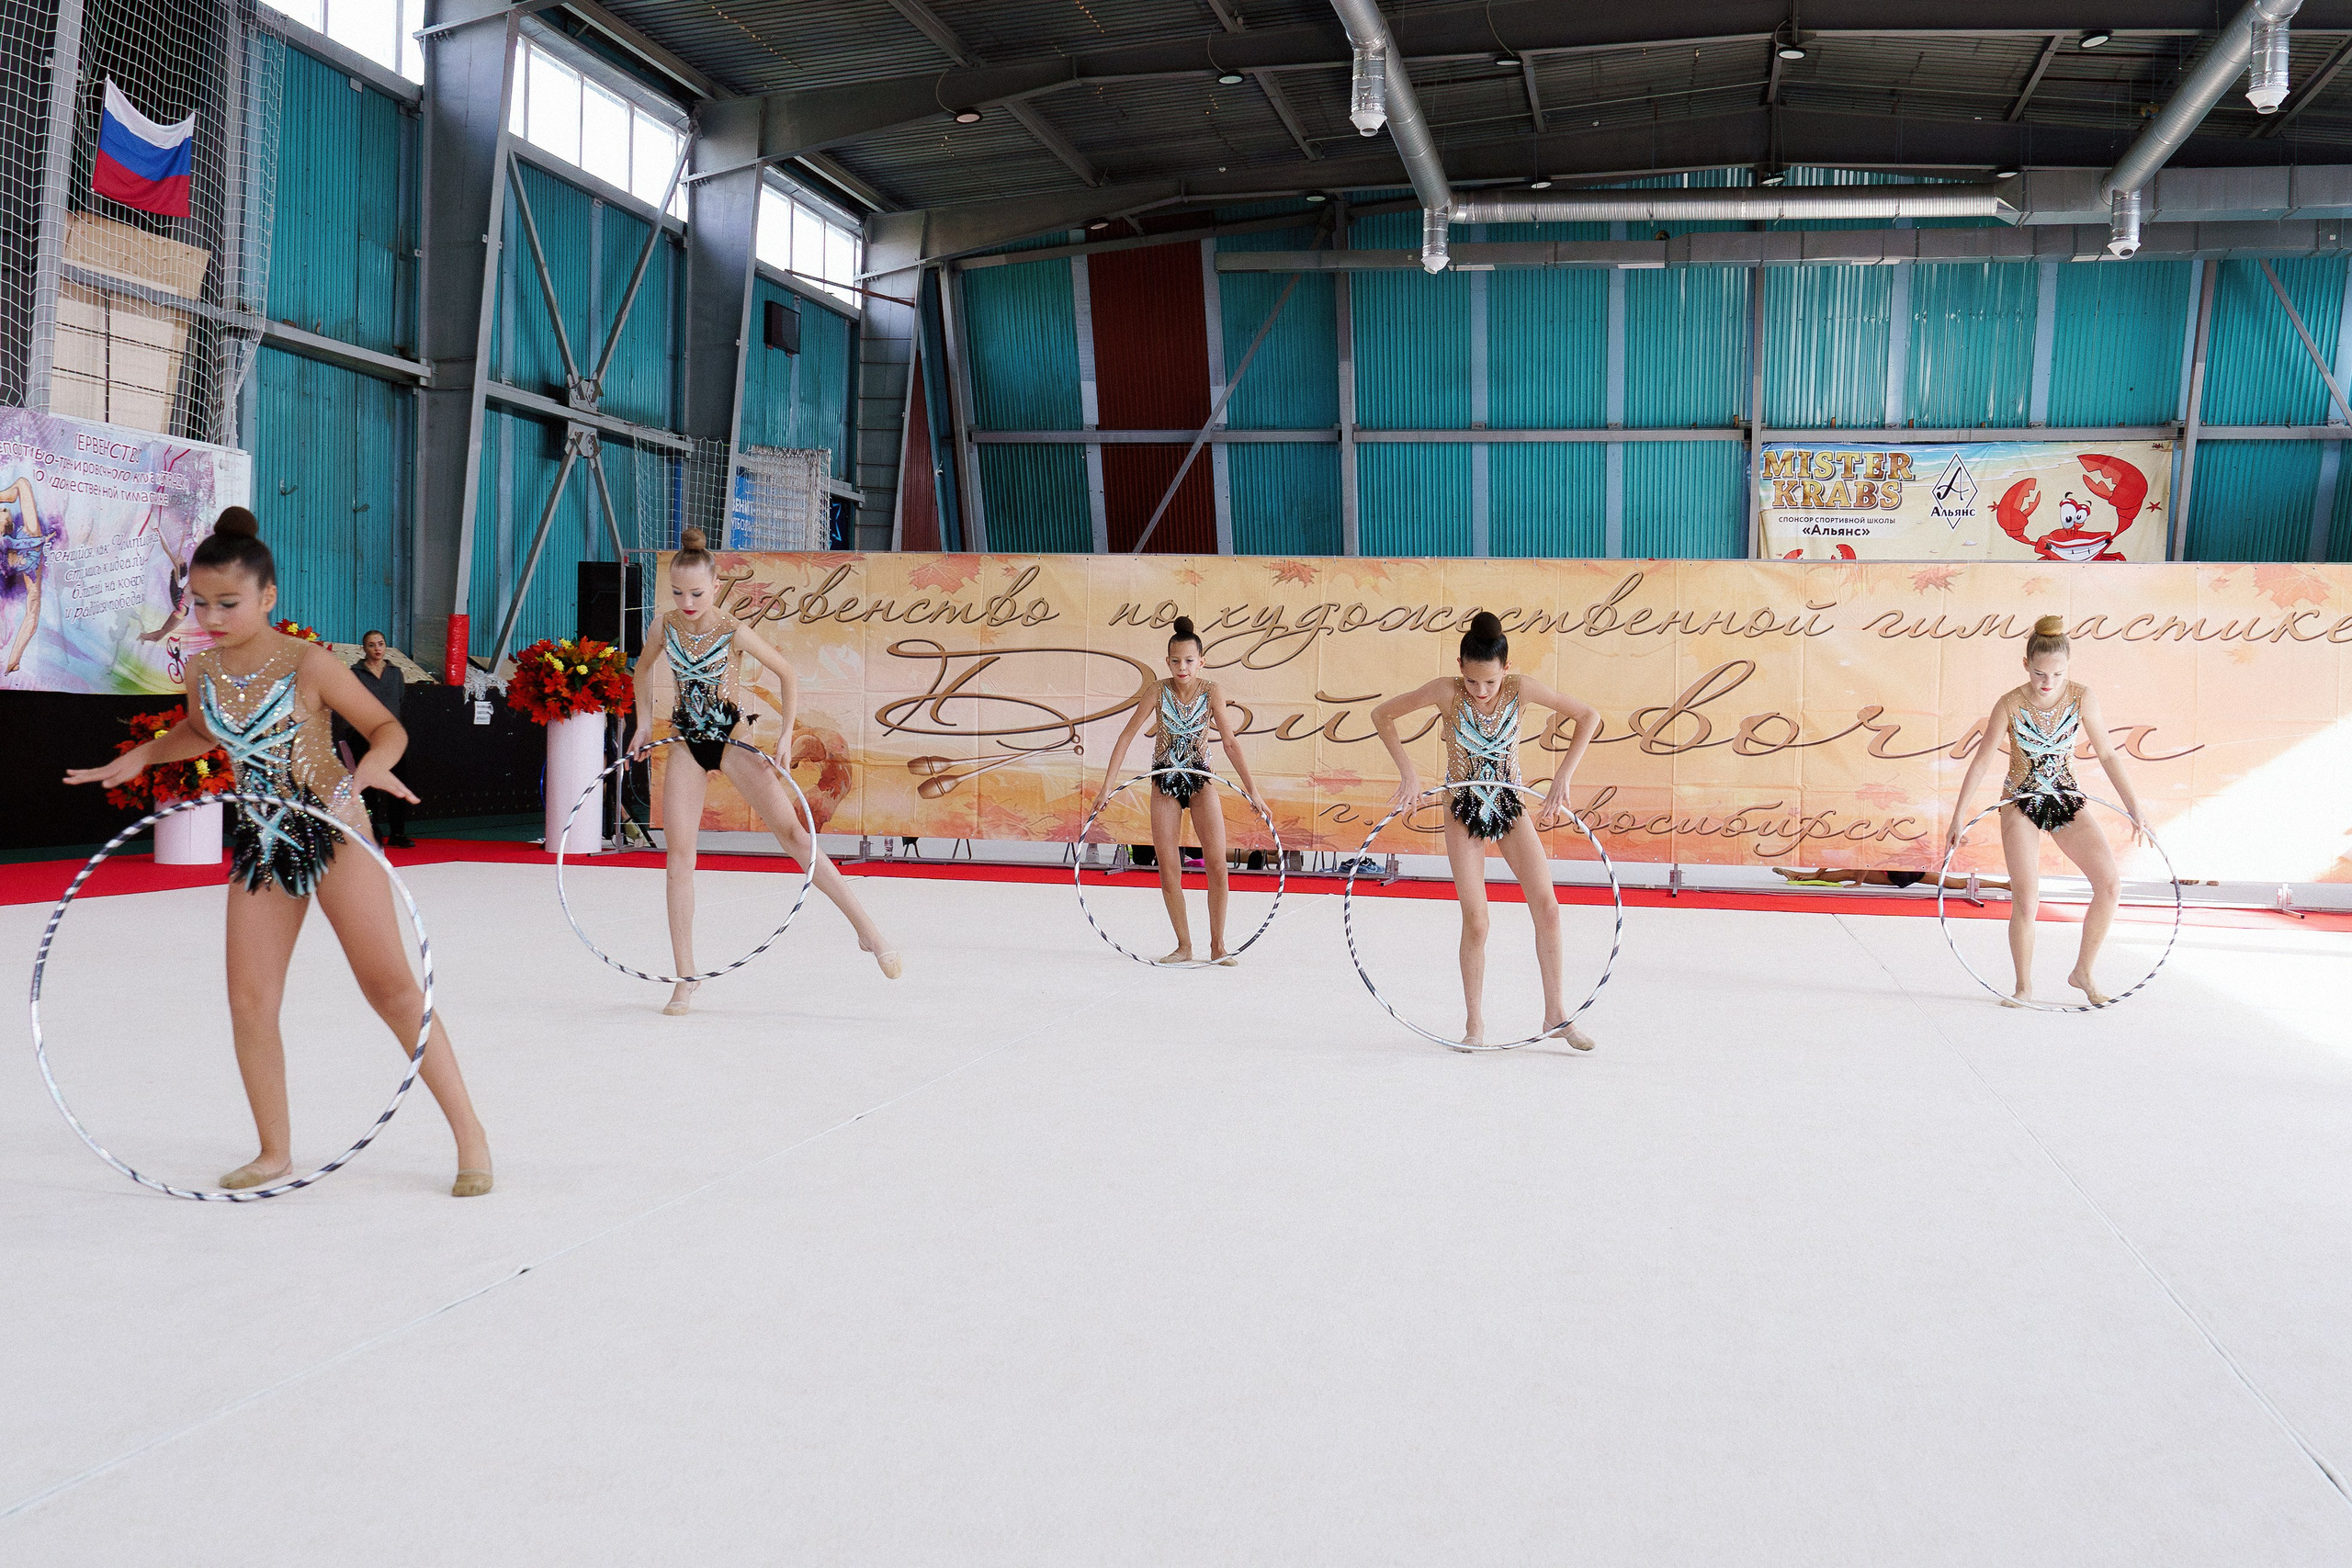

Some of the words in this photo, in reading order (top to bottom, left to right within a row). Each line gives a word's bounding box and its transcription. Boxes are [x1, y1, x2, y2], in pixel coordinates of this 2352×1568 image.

[1761, 450, 1916, 480] MISTER
[1771, 479, 1903, 509] KRABS
[1930, 506, 1976, 516] Альянс
[1802, 525, 1871, 536] «Альянс»
[1108, 599, 1190, 629] по
[1861, 605, 2352, 644] гимастике
